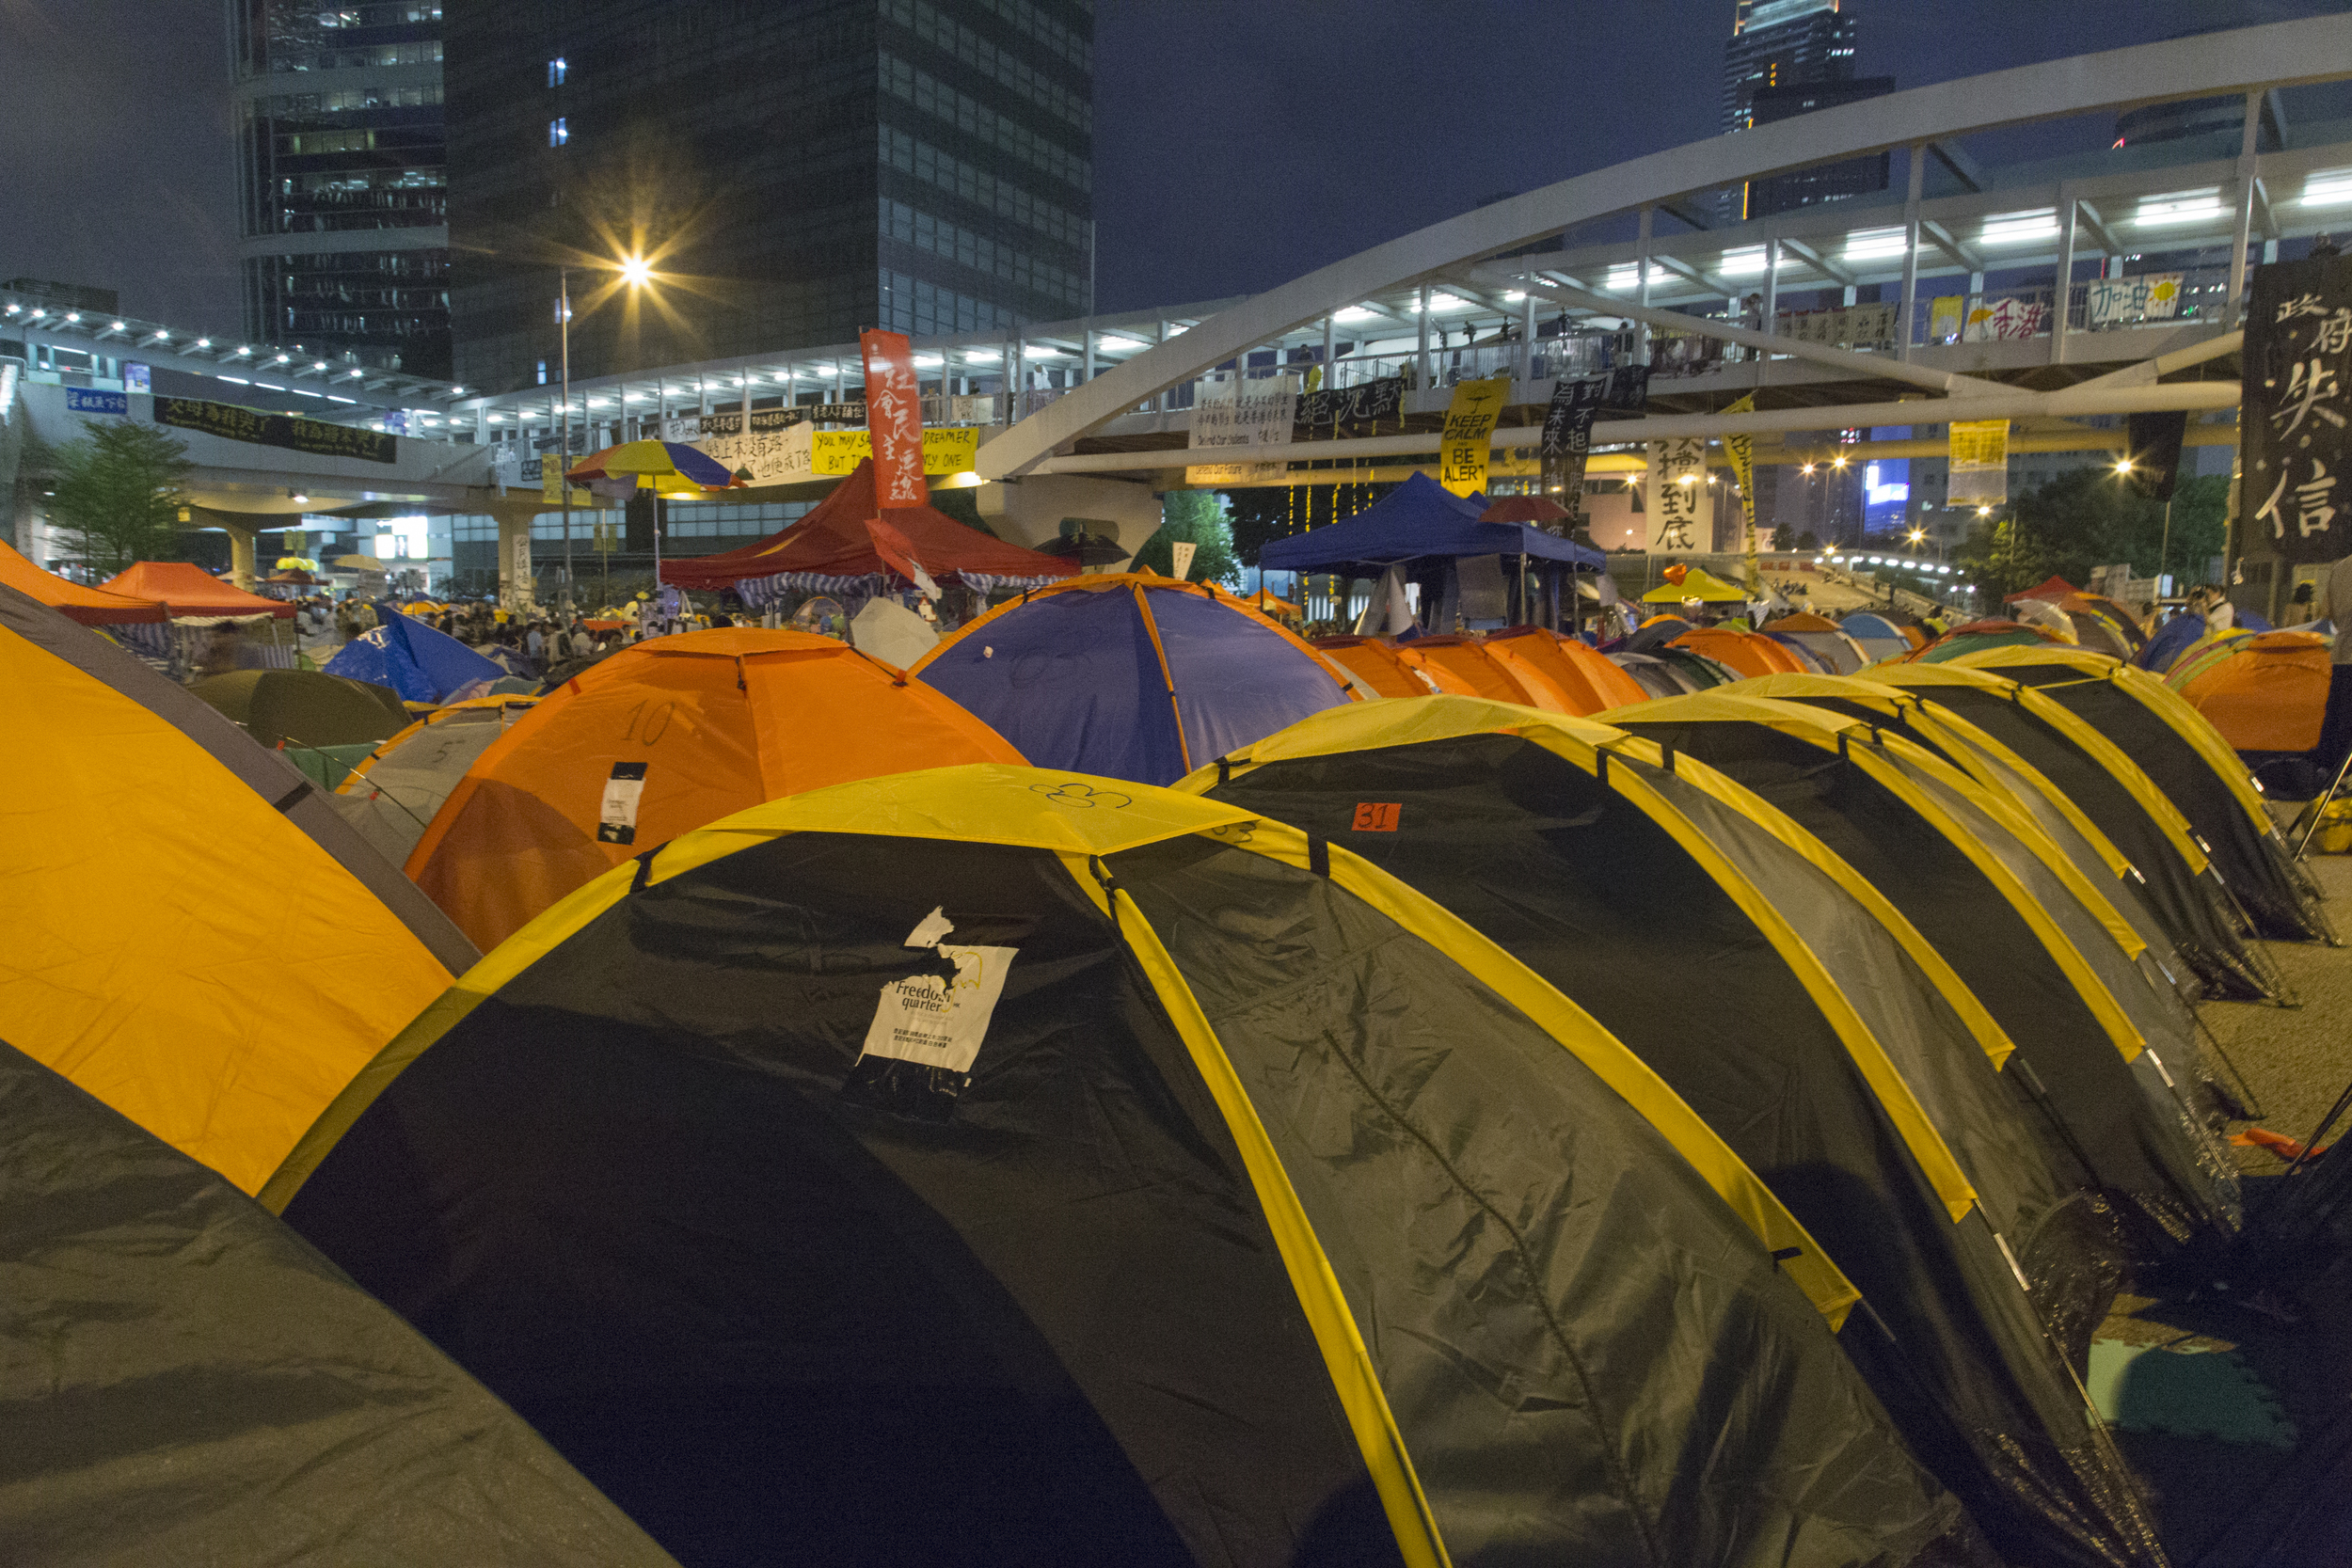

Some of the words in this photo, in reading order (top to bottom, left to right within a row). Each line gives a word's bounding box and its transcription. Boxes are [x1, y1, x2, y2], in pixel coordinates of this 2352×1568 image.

[2092, 275, 2149, 317] 加油
[1993, 298, 2045, 340] 香港
[1294, 380, 1402, 425] 絕沉默
[1449, 414, 1492, 428] KEEP
[2255, 293, 2352, 539] 政府失信
[872, 365, 922, 500] 社會民主連線
[924, 430, 971, 446] DREAMER
[1444, 427, 1487, 440] CALM
[857, 434, 872, 452] SA
[943, 453, 962, 467] ONE
[1453, 448, 1474, 465] BE
[1444, 464, 1485, 483] ALERT
[620, 699, 675, 747] 10
[1358, 802, 1389, 830] 31
[902, 997, 943, 1012] quarter
